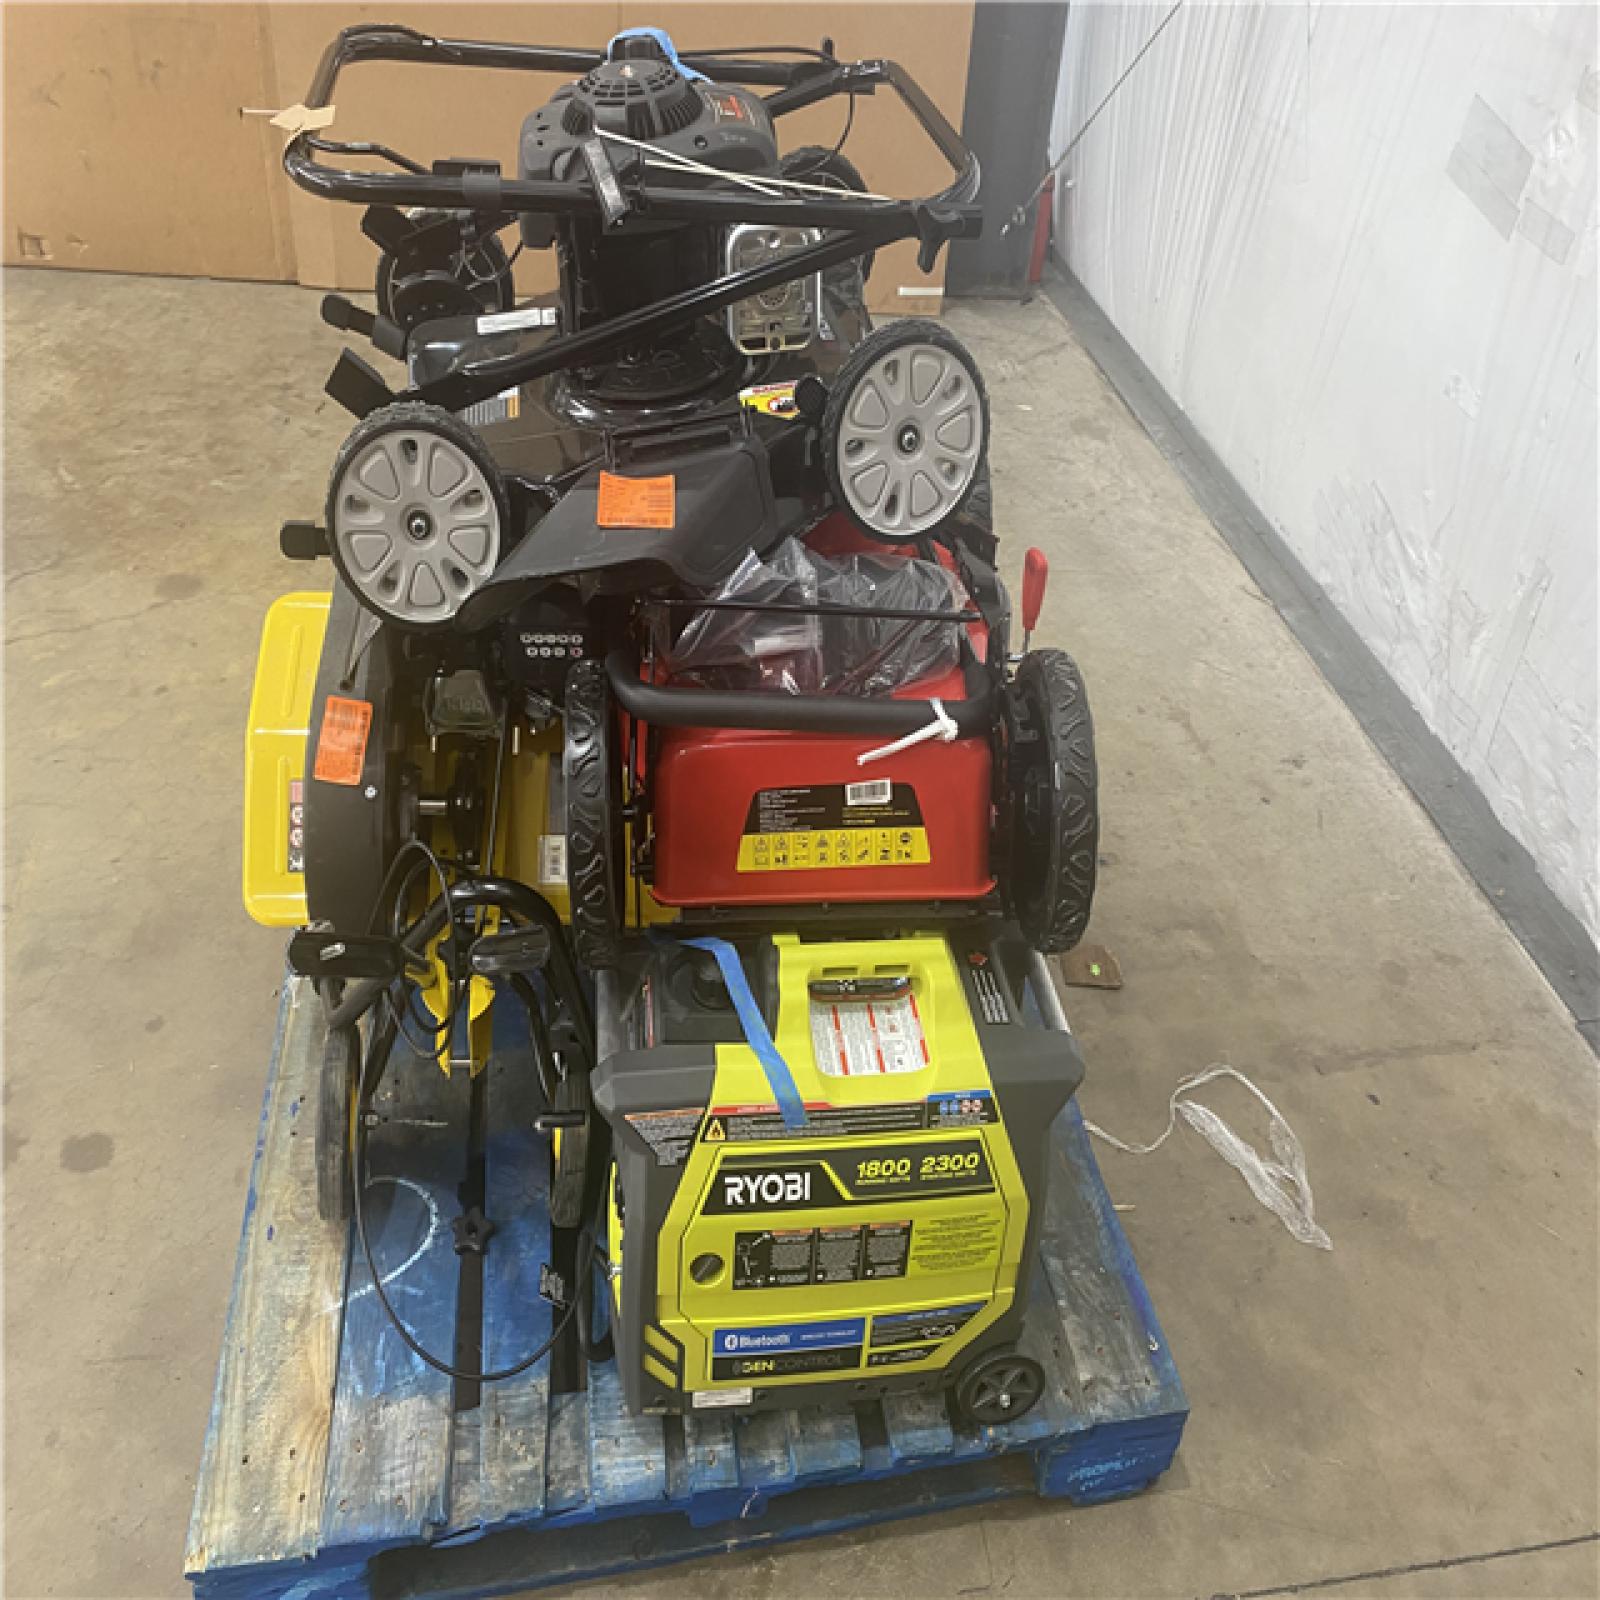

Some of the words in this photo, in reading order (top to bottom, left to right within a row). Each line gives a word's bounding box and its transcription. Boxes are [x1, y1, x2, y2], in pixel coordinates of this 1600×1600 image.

[857, 1157, 911, 1178] 1800
[920, 1152, 980, 1173] 2300
[724, 1172, 811, 1206] RYOBI
